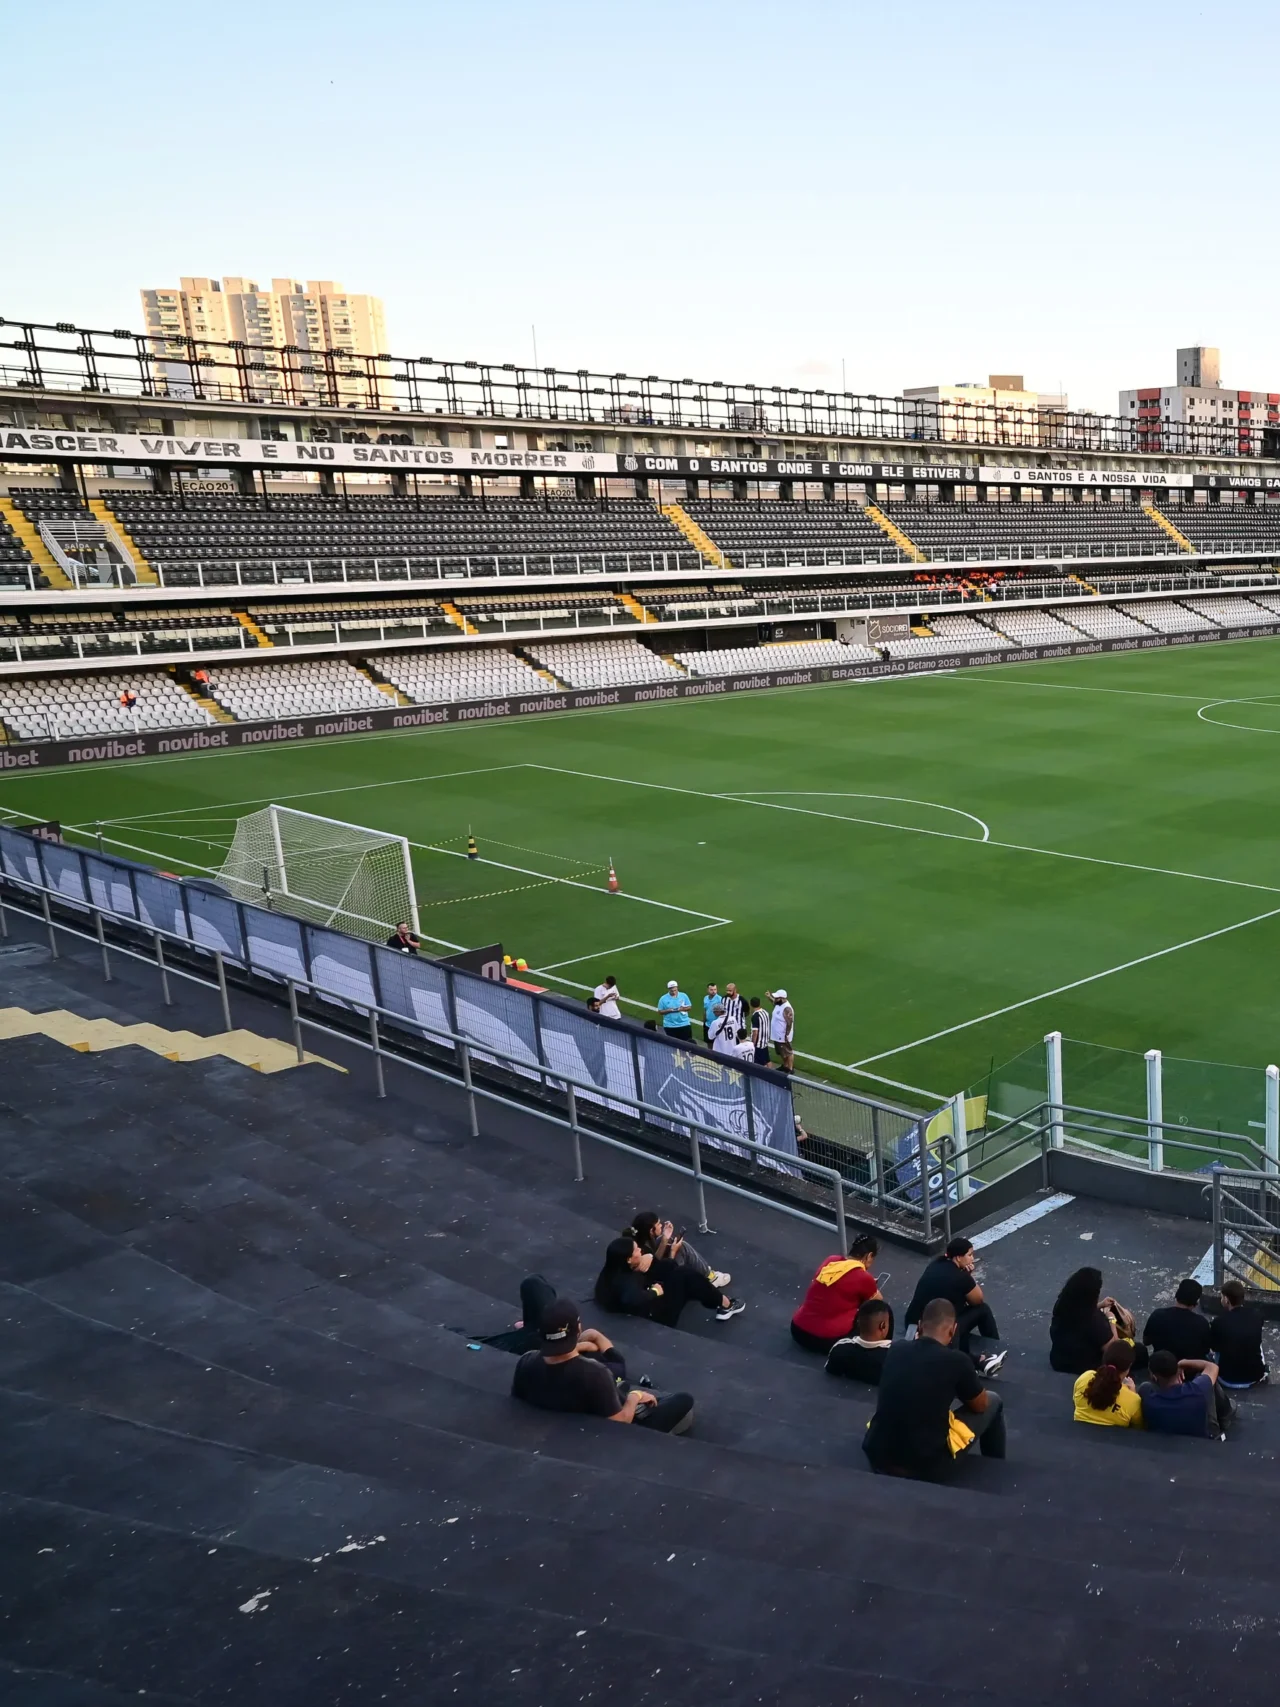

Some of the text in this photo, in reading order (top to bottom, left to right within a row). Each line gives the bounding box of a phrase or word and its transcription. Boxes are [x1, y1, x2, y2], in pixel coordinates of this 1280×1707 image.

[0, 433, 567, 467] ASCER, VIVER E NO SANTOS MORRER
[645, 458, 960, 479] COM O SANTOS ONDE E COMO ELE ESTIVER
[1014, 471, 1020, 480] O
[1028, 471, 1072, 481] SANTOS
[1090, 474, 1097, 482] A
[1102, 473, 1136, 483] NOSSA
[1142, 475, 1167, 484] VIDA
[1229, 477, 1261, 487] VAMOS
[969, 654, 1001, 666] novibet
[1007, 650, 1037, 662] novibet
[1043, 645, 1071, 657] novibet
[1075, 642, 1102, 655] novibet
[1112, 639, 1138, 651] novibet
[1142, 637, 1167, 648] novibet
[1171, 634, 1195, 645] novibet
[1198, 632, 1220, 642] novibet
[1227, 628, 1250, 639] novibet
[1253, 626, 1273, 636] novibet
[832, 658, 961, 679] BRASILEIRÃO Betano 2026
[0, 671, 812, 768] ibet novibet novibet novibet novibet novibet novibet novibet novibet novibet novibet novibet novibet
[724, 1026, 734, 1041] 18
